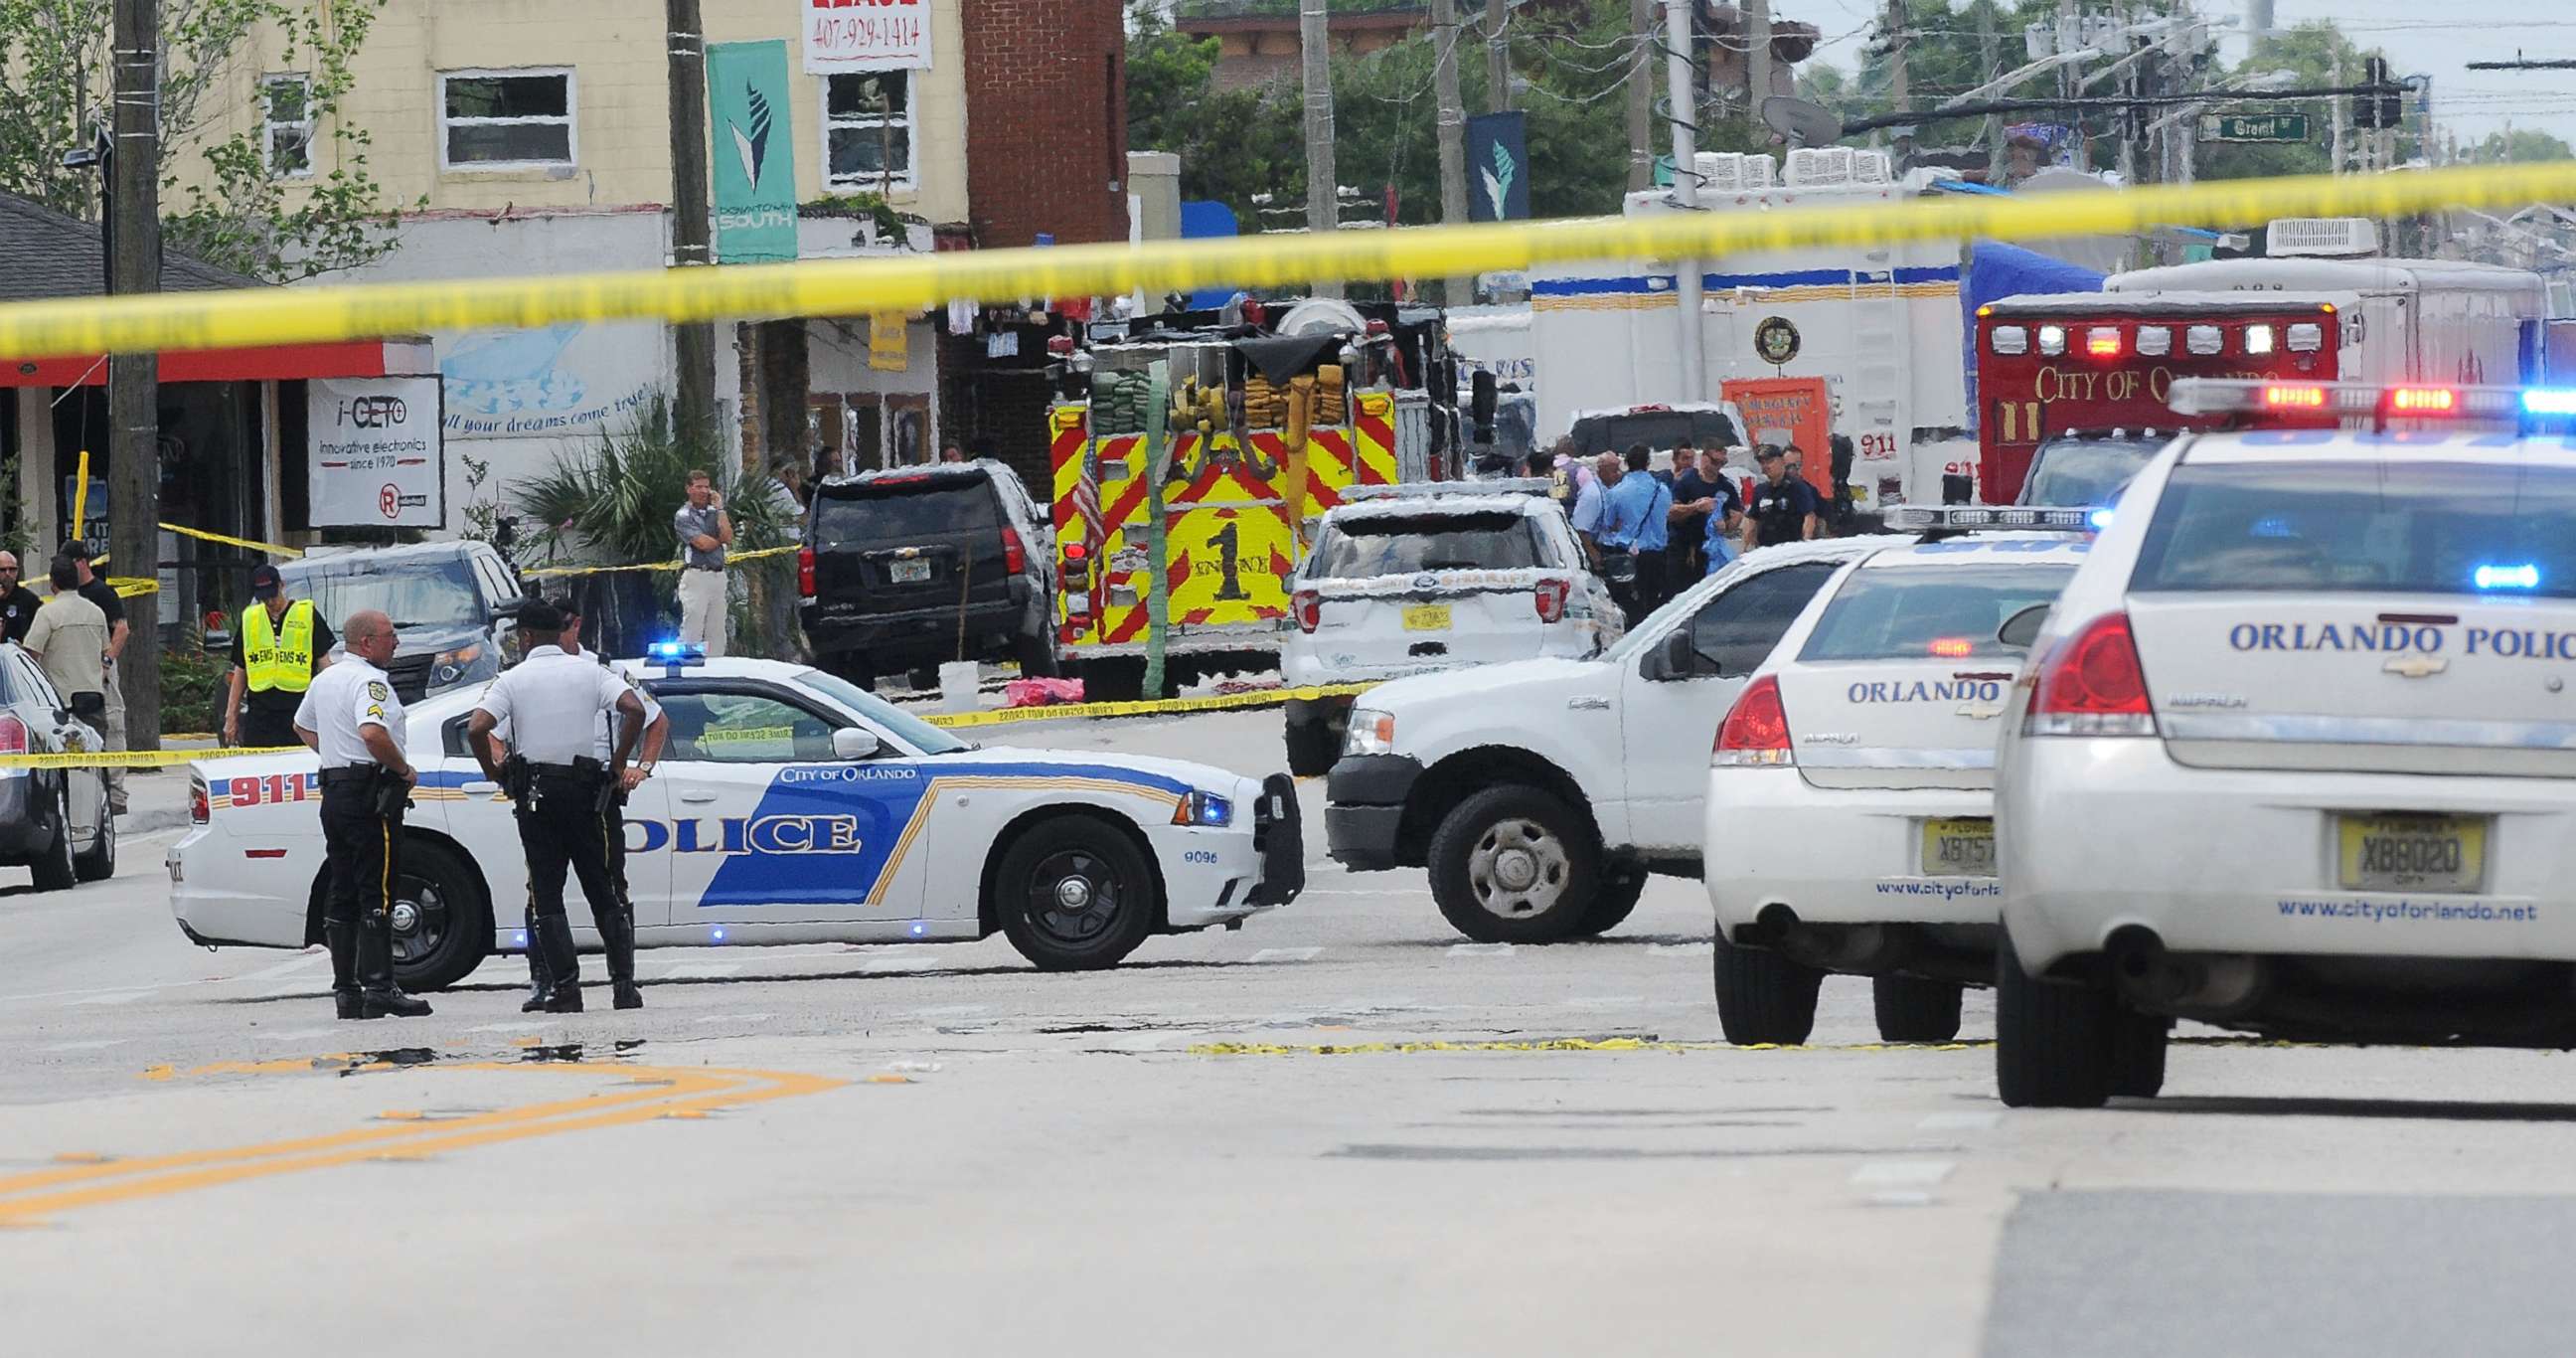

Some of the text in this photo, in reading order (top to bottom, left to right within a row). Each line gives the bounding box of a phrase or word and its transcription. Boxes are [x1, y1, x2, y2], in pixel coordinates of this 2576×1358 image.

[812, 17, 920, 49] 407-929-1414
[719, 212, 793, 231] SOUTH
[2036, 366, 2100, 404] CITY
[2105, 371, 2140, 401] OF
[445, 413, 461, 429] ll
[464, 419, 500, 434] your
[506, 414, 567, 432] dreams
[570, 406, 609, 425] come
[2001, 401, 2038, 441] 11
[319, 437, 426, 454] Innovative electronics
[1860, 433, 1896, 456] 911
[350, 455, 396, 470] since 1970
[1207, 522, 1251, 600] 1
[2229, 623, 2443, 652] ORLANDO
[259, 649, 273, 663] EMS
[279, 651, 295, 664] EMS
[1849, 681, 2000, 703] ORLANDO
[779, 767, 916, 782] CITY OF ORLANDO
[231, 773, 305, 806] 911
[623, 816, 861, 854] OLICE
[2278, 900, 2536, 923] www.cityoforlando.net
